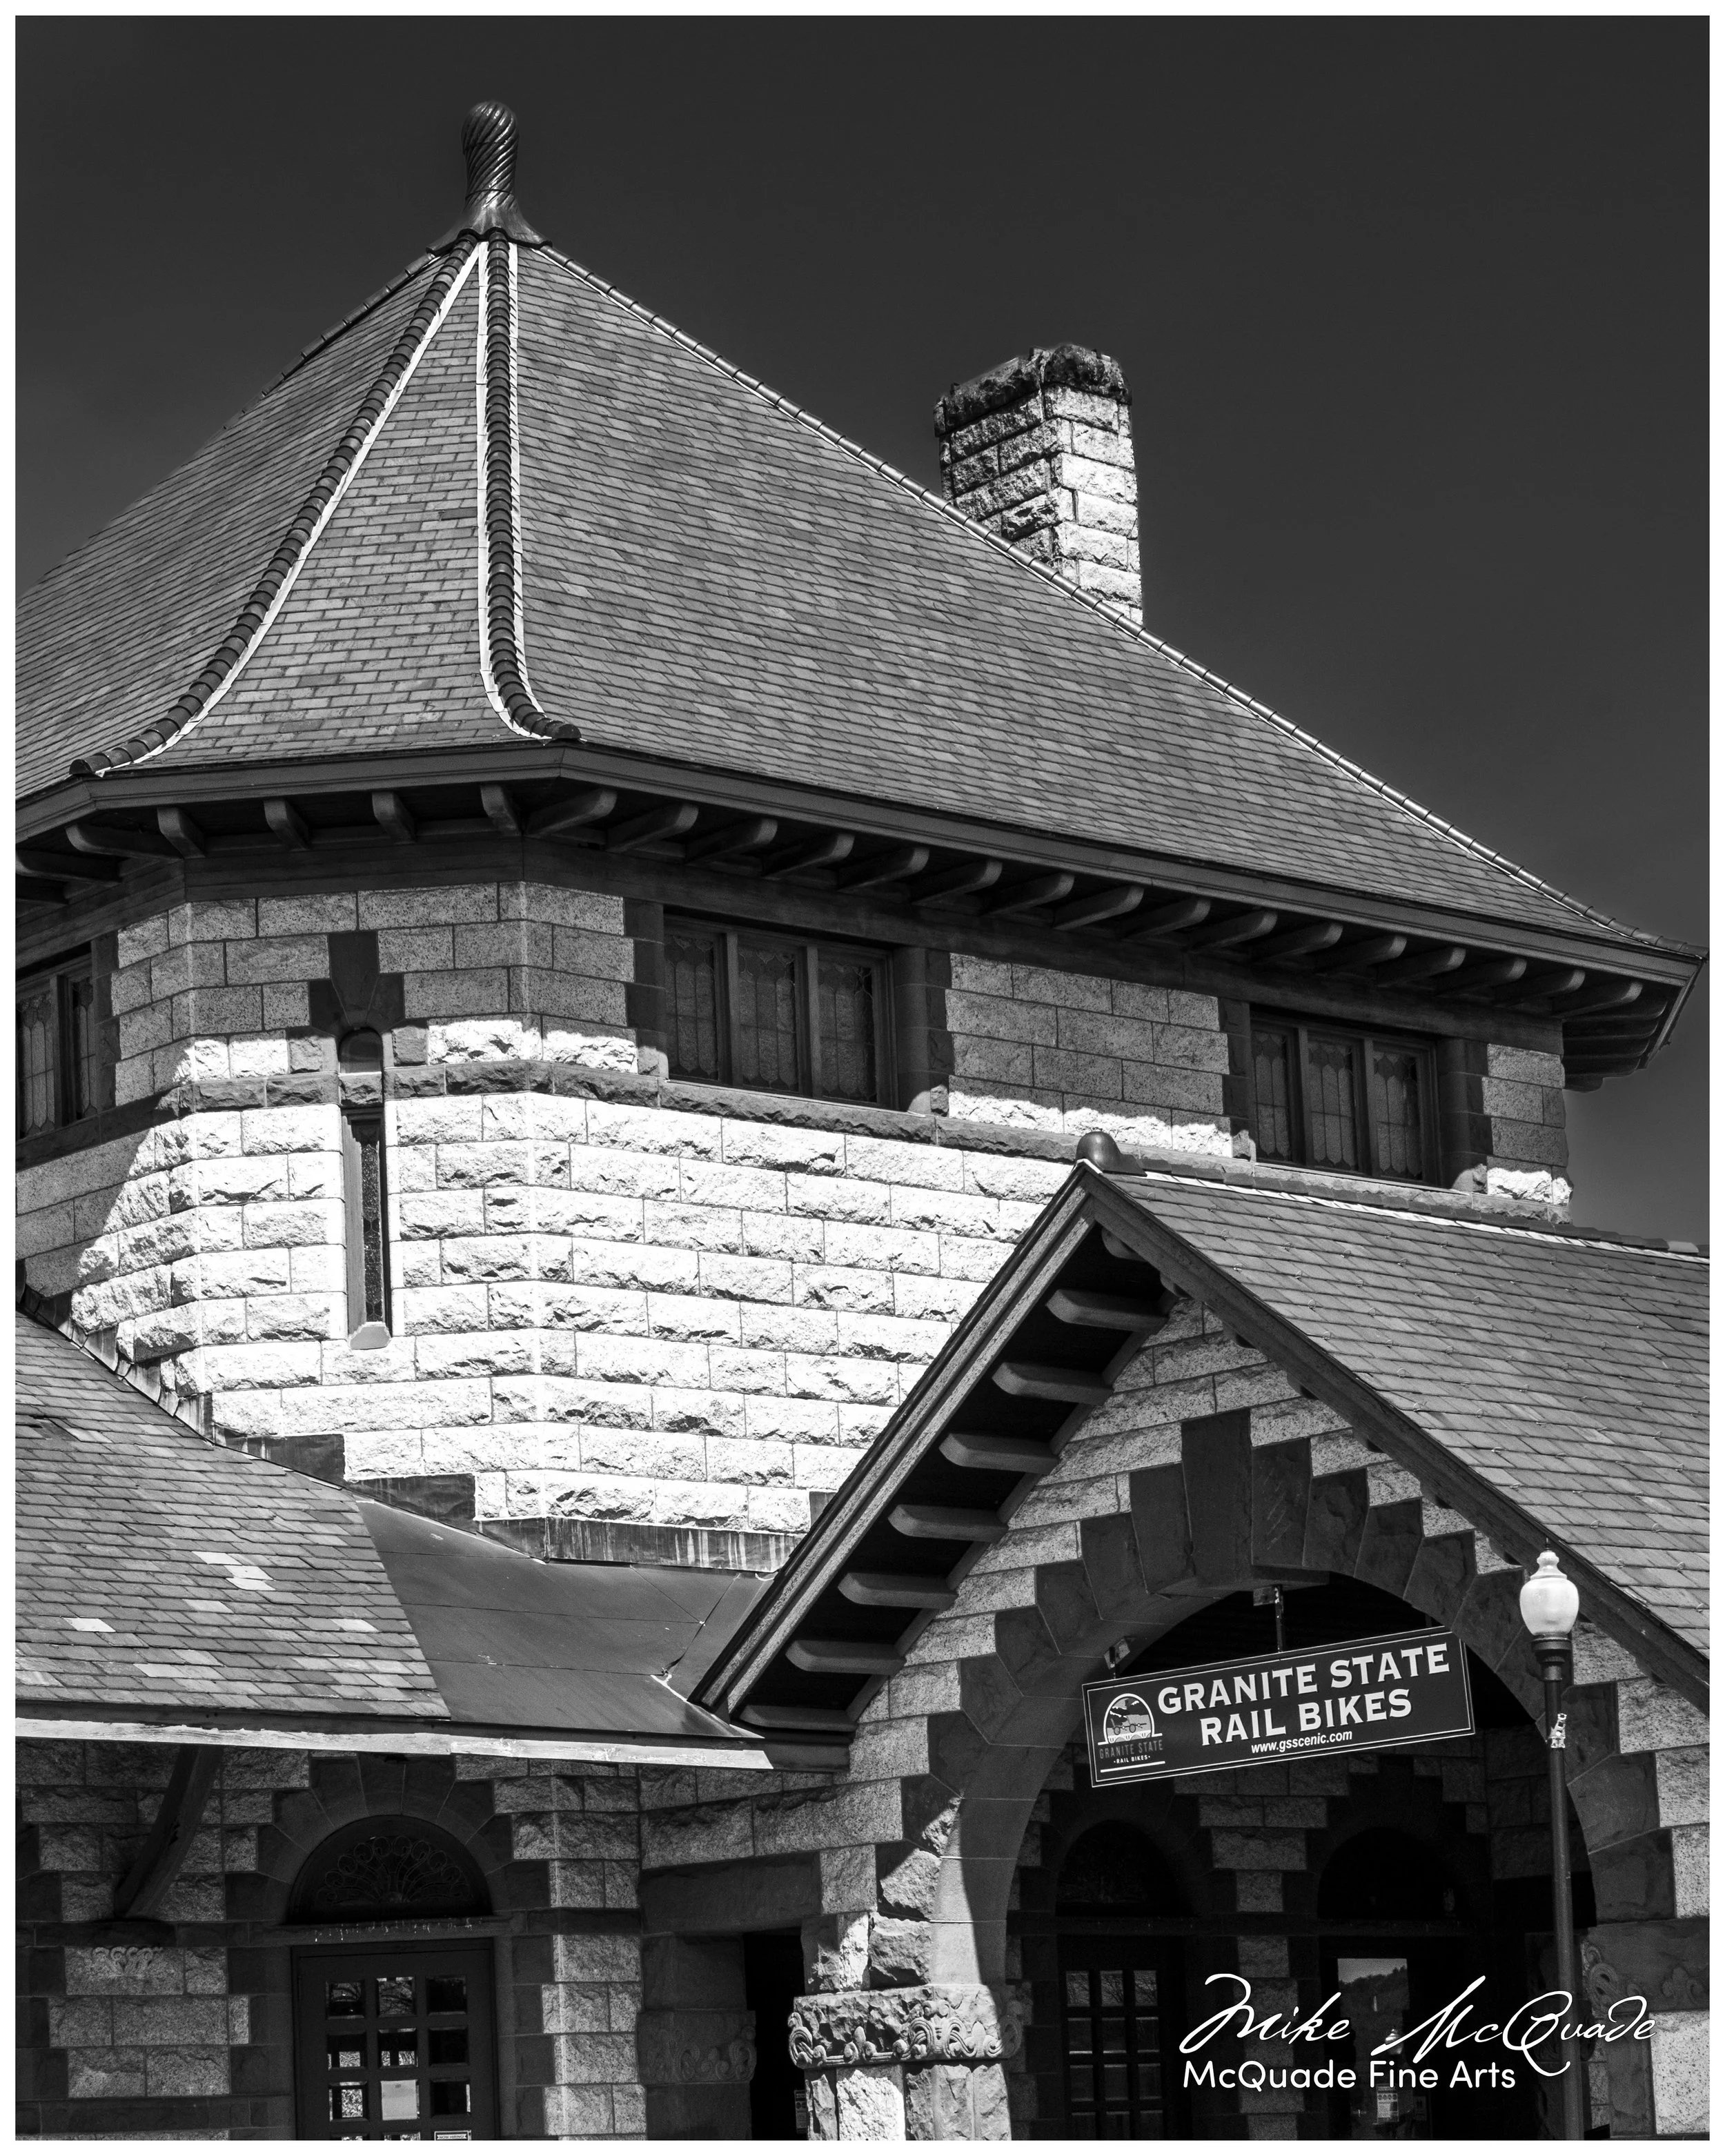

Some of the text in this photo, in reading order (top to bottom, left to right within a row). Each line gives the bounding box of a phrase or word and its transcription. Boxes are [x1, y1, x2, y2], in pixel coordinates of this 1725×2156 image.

[1158, 1643, 1450, 1714] GRANITE STATE
[1200, 1689, 1412, 1746] RAIL BIKES
[1099, 1740, 1163, 1759] GRANITE STATE
[1251, 1730, 1352, 1754] www.gsscenic.com
